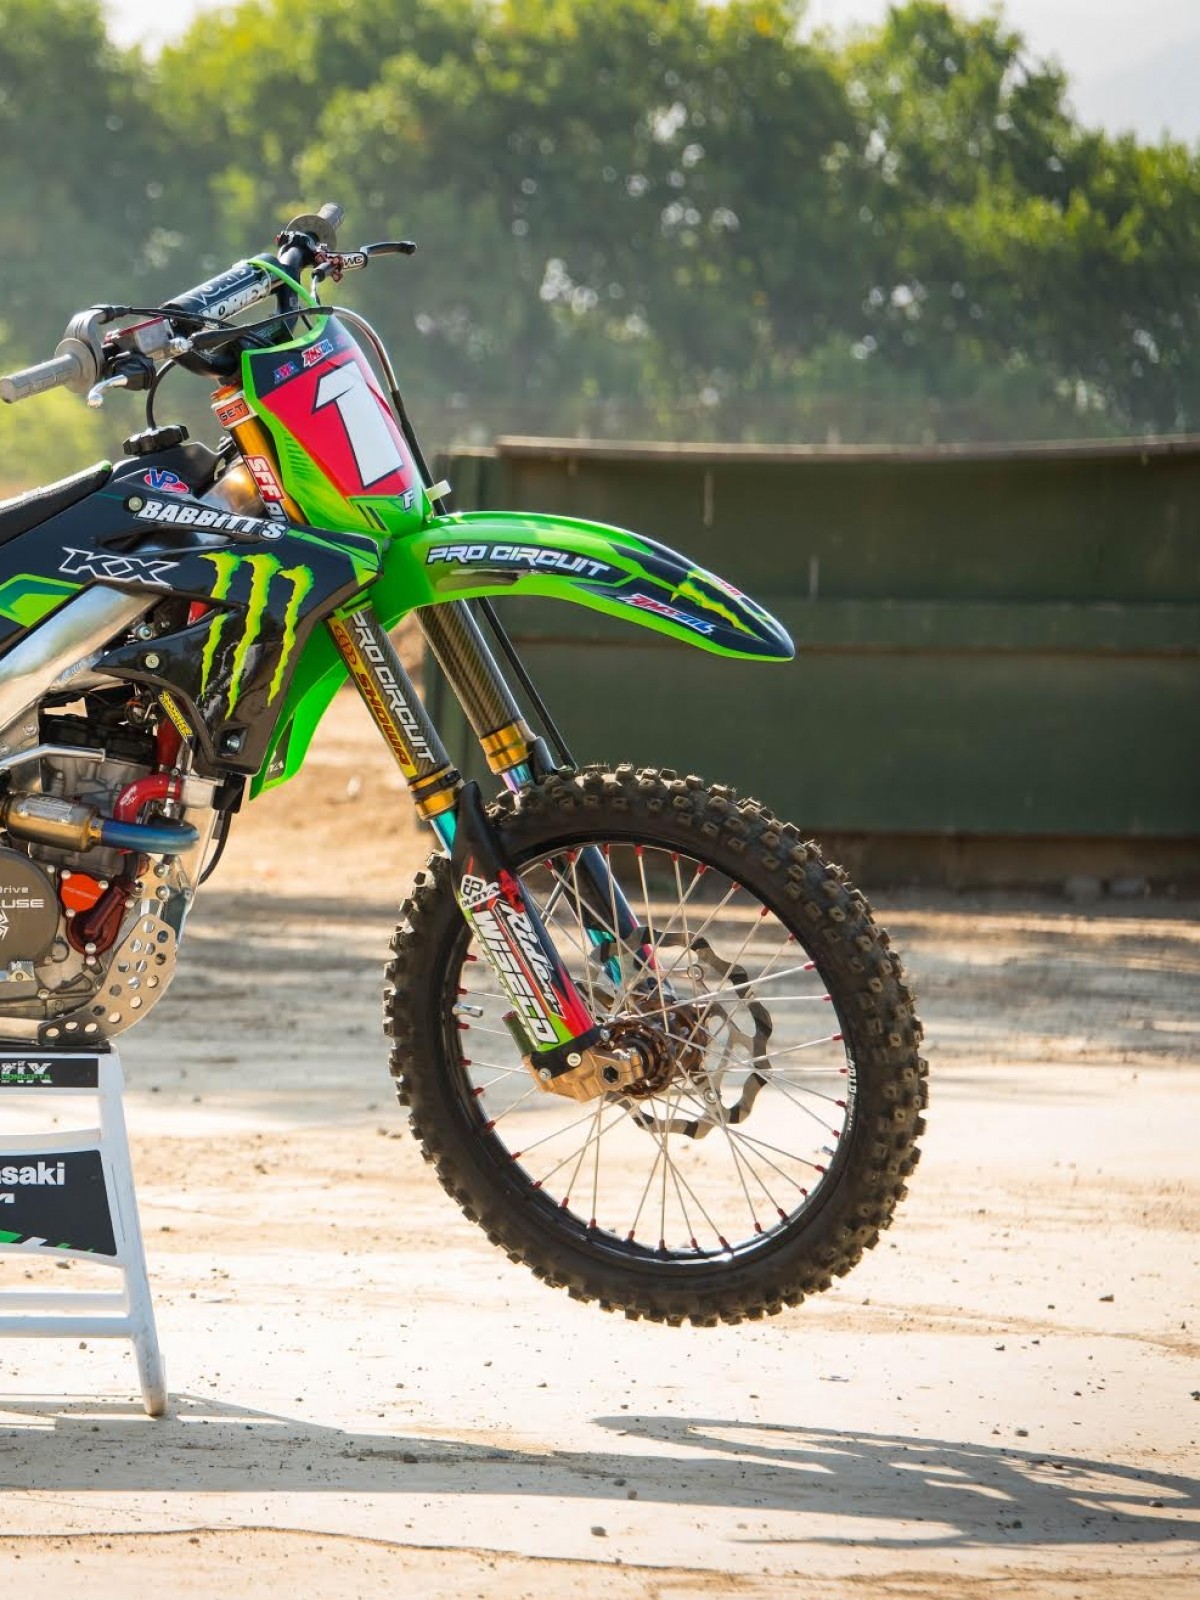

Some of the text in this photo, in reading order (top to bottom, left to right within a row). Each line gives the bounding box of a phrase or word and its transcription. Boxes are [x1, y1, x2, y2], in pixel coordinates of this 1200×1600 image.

[220, 403, 244, 421] GET
[311, 360, 404, 489] 1
[149, 467, 180, 489] VP
[246, 456, 283, 500] SFF
[138, 500, 286, 540] BABBITT'S
[58, 547, 180, 590] KX
[426, 544, 610, 578] PRO CIRCUIT
[352, 611, 436, 764] PRO CIRCUIT
[356, 672, 411, 766] SHOWA
